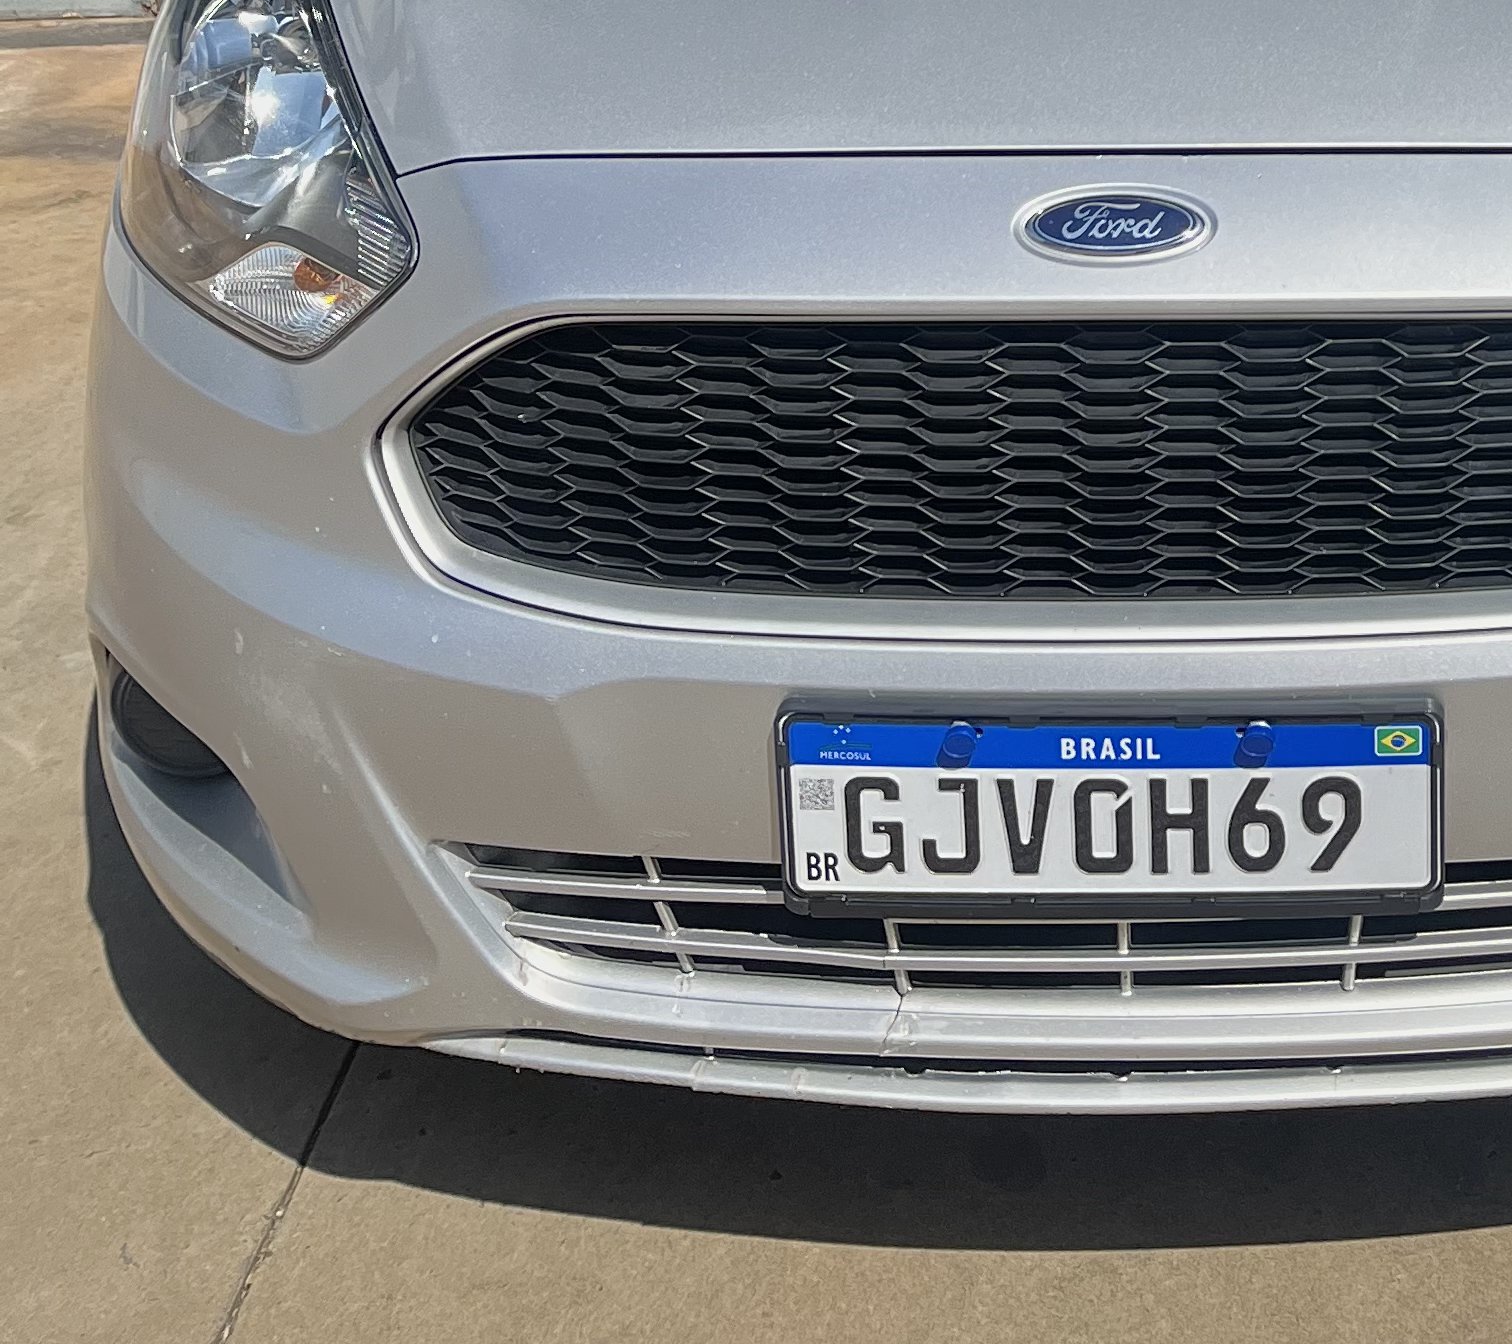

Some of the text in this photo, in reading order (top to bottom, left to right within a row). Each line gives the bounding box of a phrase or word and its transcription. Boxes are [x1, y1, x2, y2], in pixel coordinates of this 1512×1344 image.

[1061, 201, 1162, 240] Ford
[819, 736, 1161, 761] MERCOSUL BRASIL
[806, 852, 841, 882] BR
